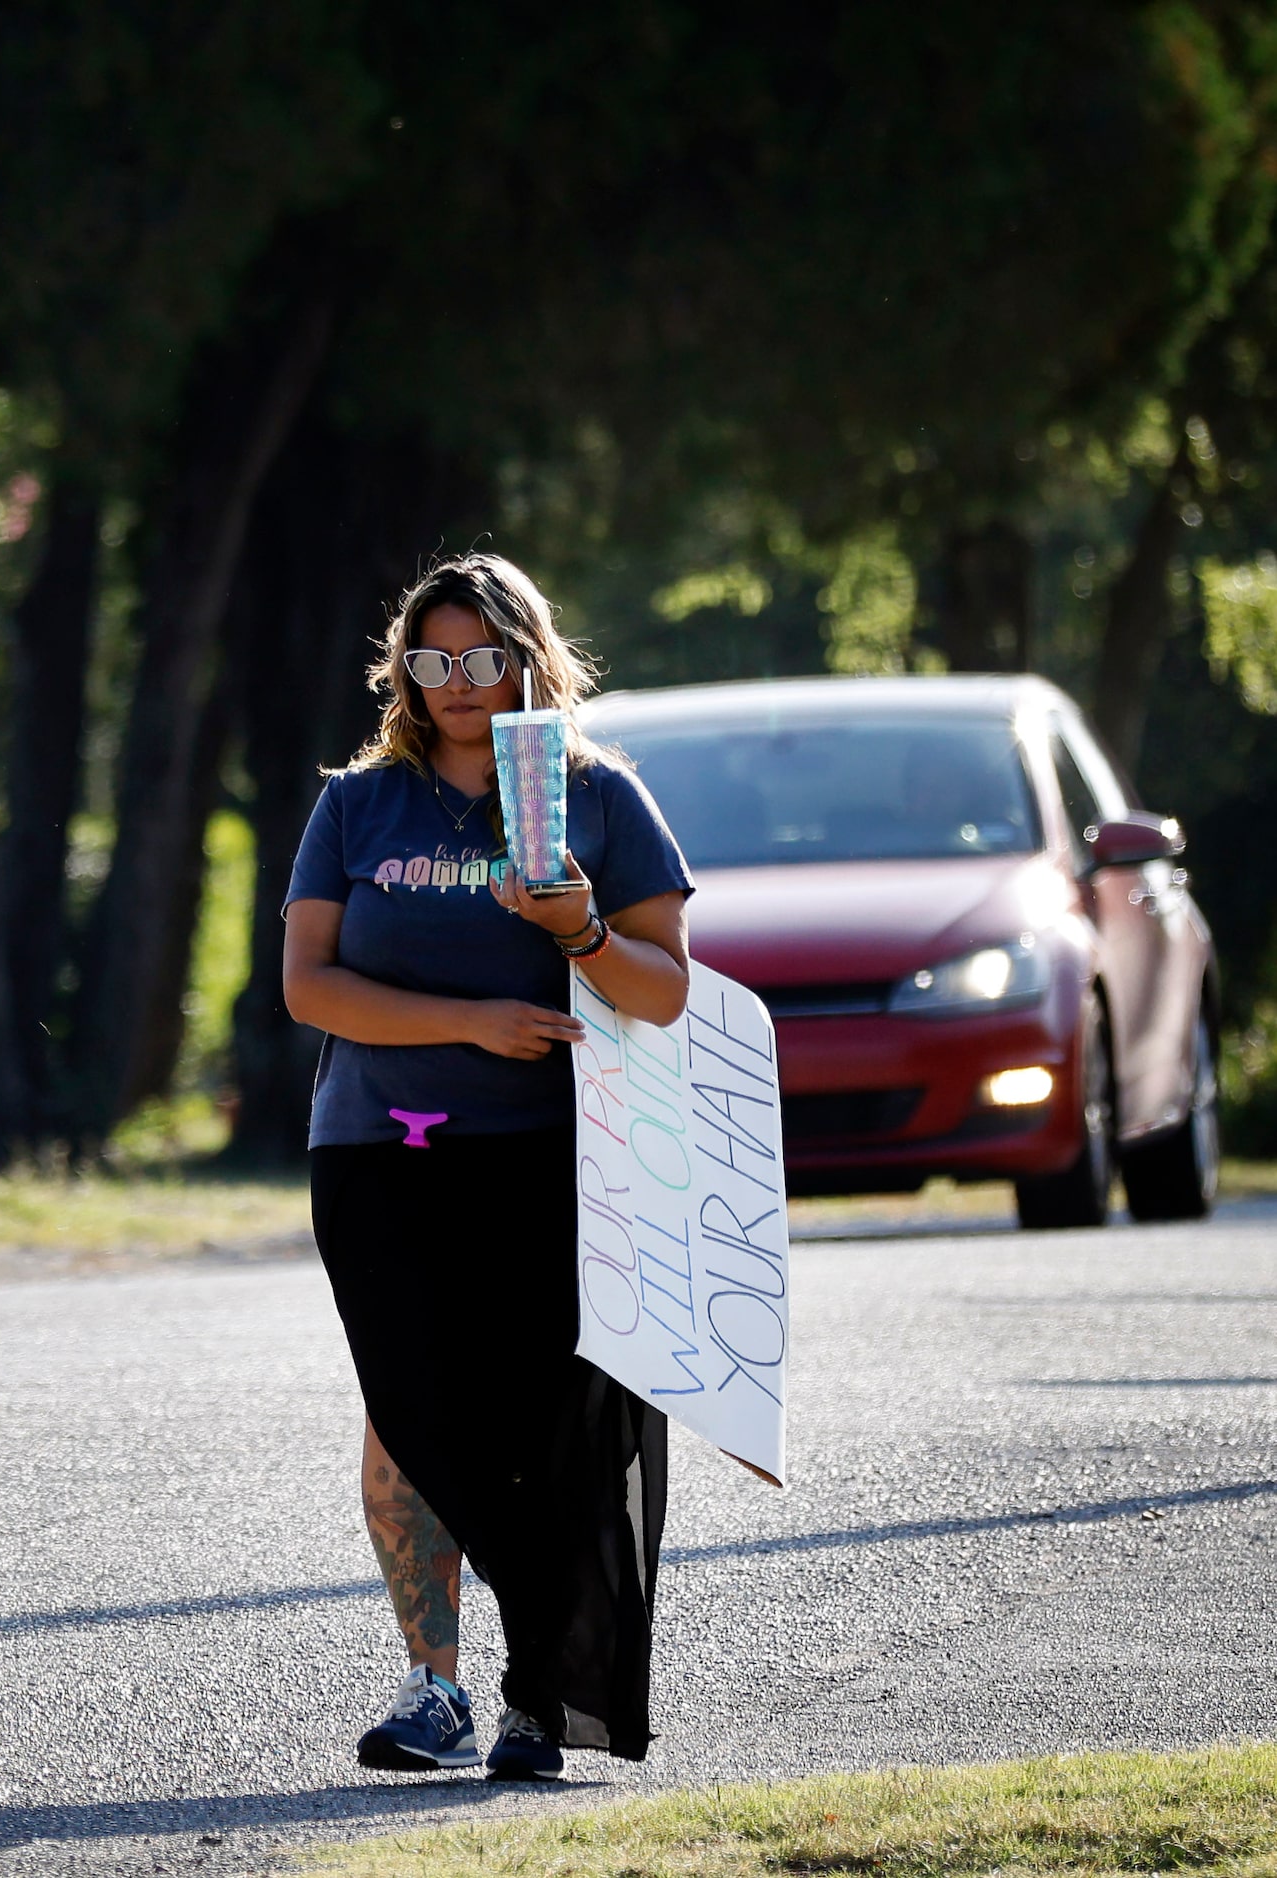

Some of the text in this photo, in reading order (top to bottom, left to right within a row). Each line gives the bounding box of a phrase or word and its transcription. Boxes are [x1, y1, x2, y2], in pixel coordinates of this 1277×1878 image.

[581, 1155, 641, 1335] OUR
[687, 991, 785, 1407] YOUR HATE
[635, 1213, 705, 1396] WILL
